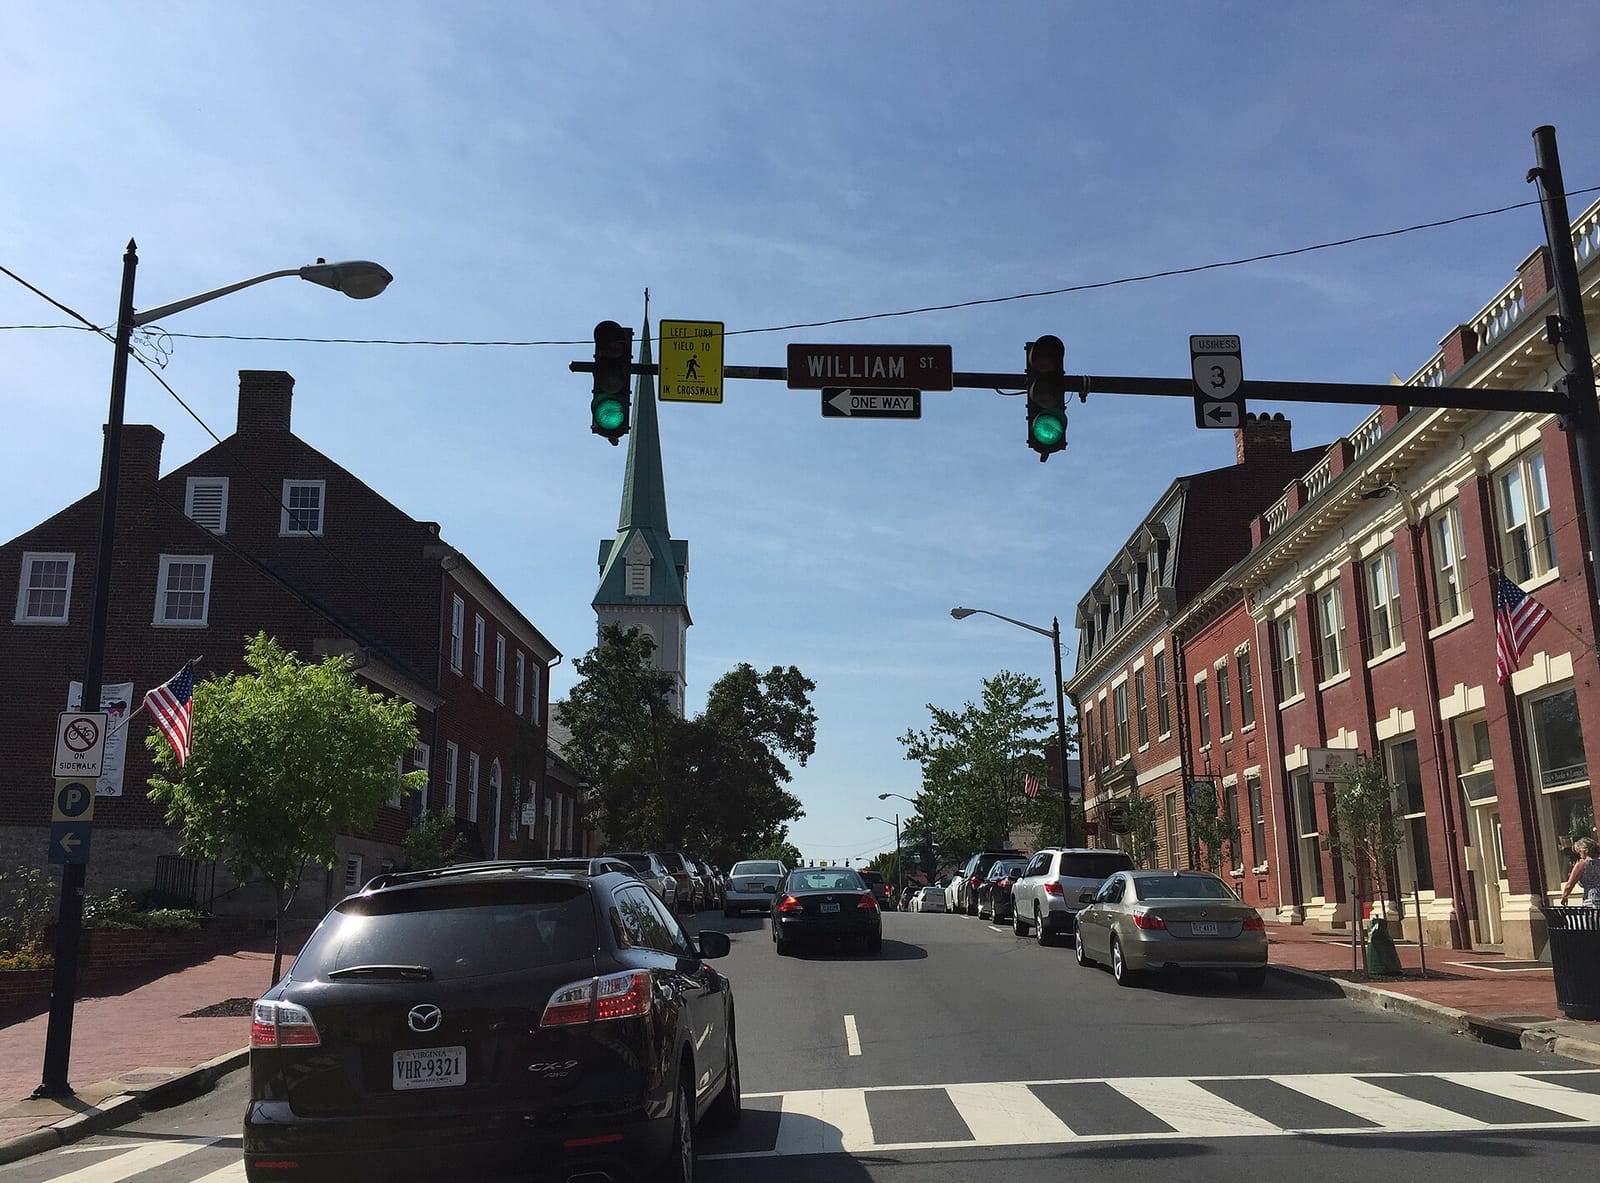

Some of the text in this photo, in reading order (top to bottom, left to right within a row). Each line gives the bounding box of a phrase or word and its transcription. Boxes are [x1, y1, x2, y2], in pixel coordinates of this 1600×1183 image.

[670, 327, 713, 338] LEFT TURN
[673, 341, 711, 352] YIELD TO
[807, 355, 904, 379] WILLIAM
[1210, 365, 1226, 388] 3
[663, 384, 719, 397] IN CROSSWALK
[851, 397, 909, 409] ONE WAY
[74, 752, 85, 760] ON
[59, 762, 97, 770] SIDEWALK
[65, 789, 82, 810] P
[412, 1050, 447, 1059] VIRGINIA
[397, 1057, 460, 1080] VHR-9321
[527, 1059, 578, 1072] CX-9
